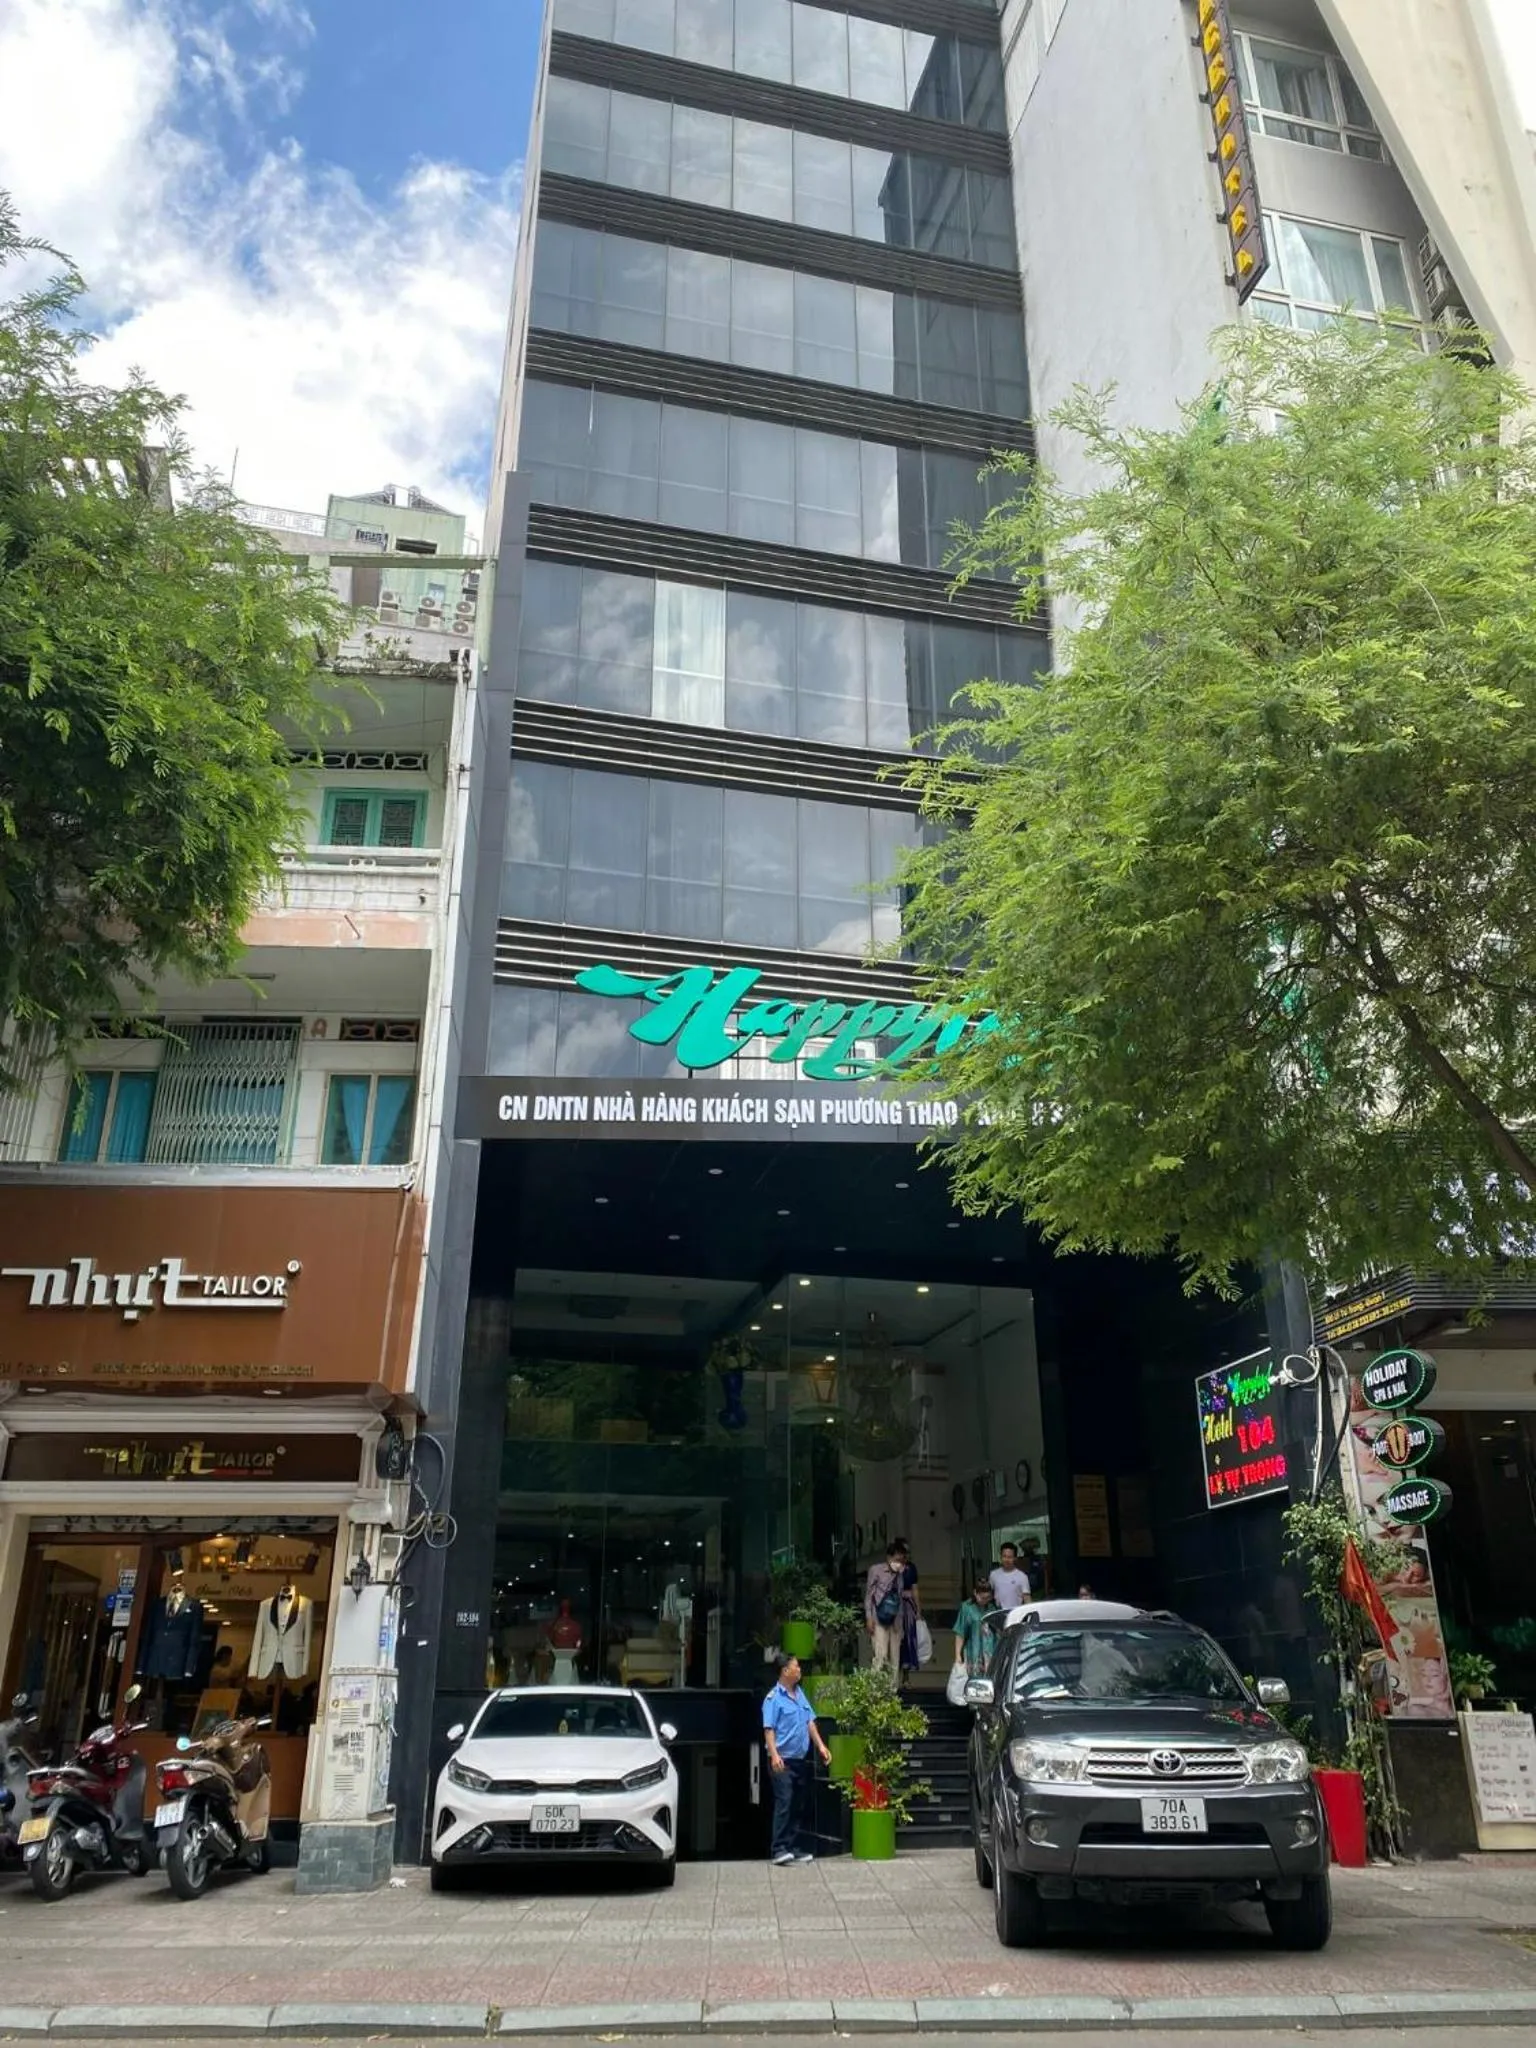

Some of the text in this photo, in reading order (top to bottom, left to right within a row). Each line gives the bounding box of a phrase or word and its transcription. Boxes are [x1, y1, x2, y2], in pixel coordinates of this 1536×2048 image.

[499, 1095, 527, 1121] CN
[533, 1095, 588, 1122] DNTN
[594, 1091, 635, 1122] NHÀ
[641, 1092, 696, 1123] HÀNG
[702, 1092, 768, 1123] KHÁCH
[774, 1098, 815, 1128] SẠN
[821, 1096, 902, 1125] PHƯƠNG
[202, 1274, 288, 1297] TAILOR
[1365, 1358, 1408, 1387] HOLIDAY
[1373, 1381, 1408, 1404] SPA & NAIL
[1205, 1406, 1234, 1445] Hotel
[1237, 1415, 1275, 1453] 104
[218, 1452, 275, 1468] TAILOR
[1387, 1489, 1431, 1514] MASSAGE
[545, 1806, 566, 1818] 60K
[1160, 1798, 1188, 1814] 70A
[1150, 1815, 1199, 1830] 383.61
